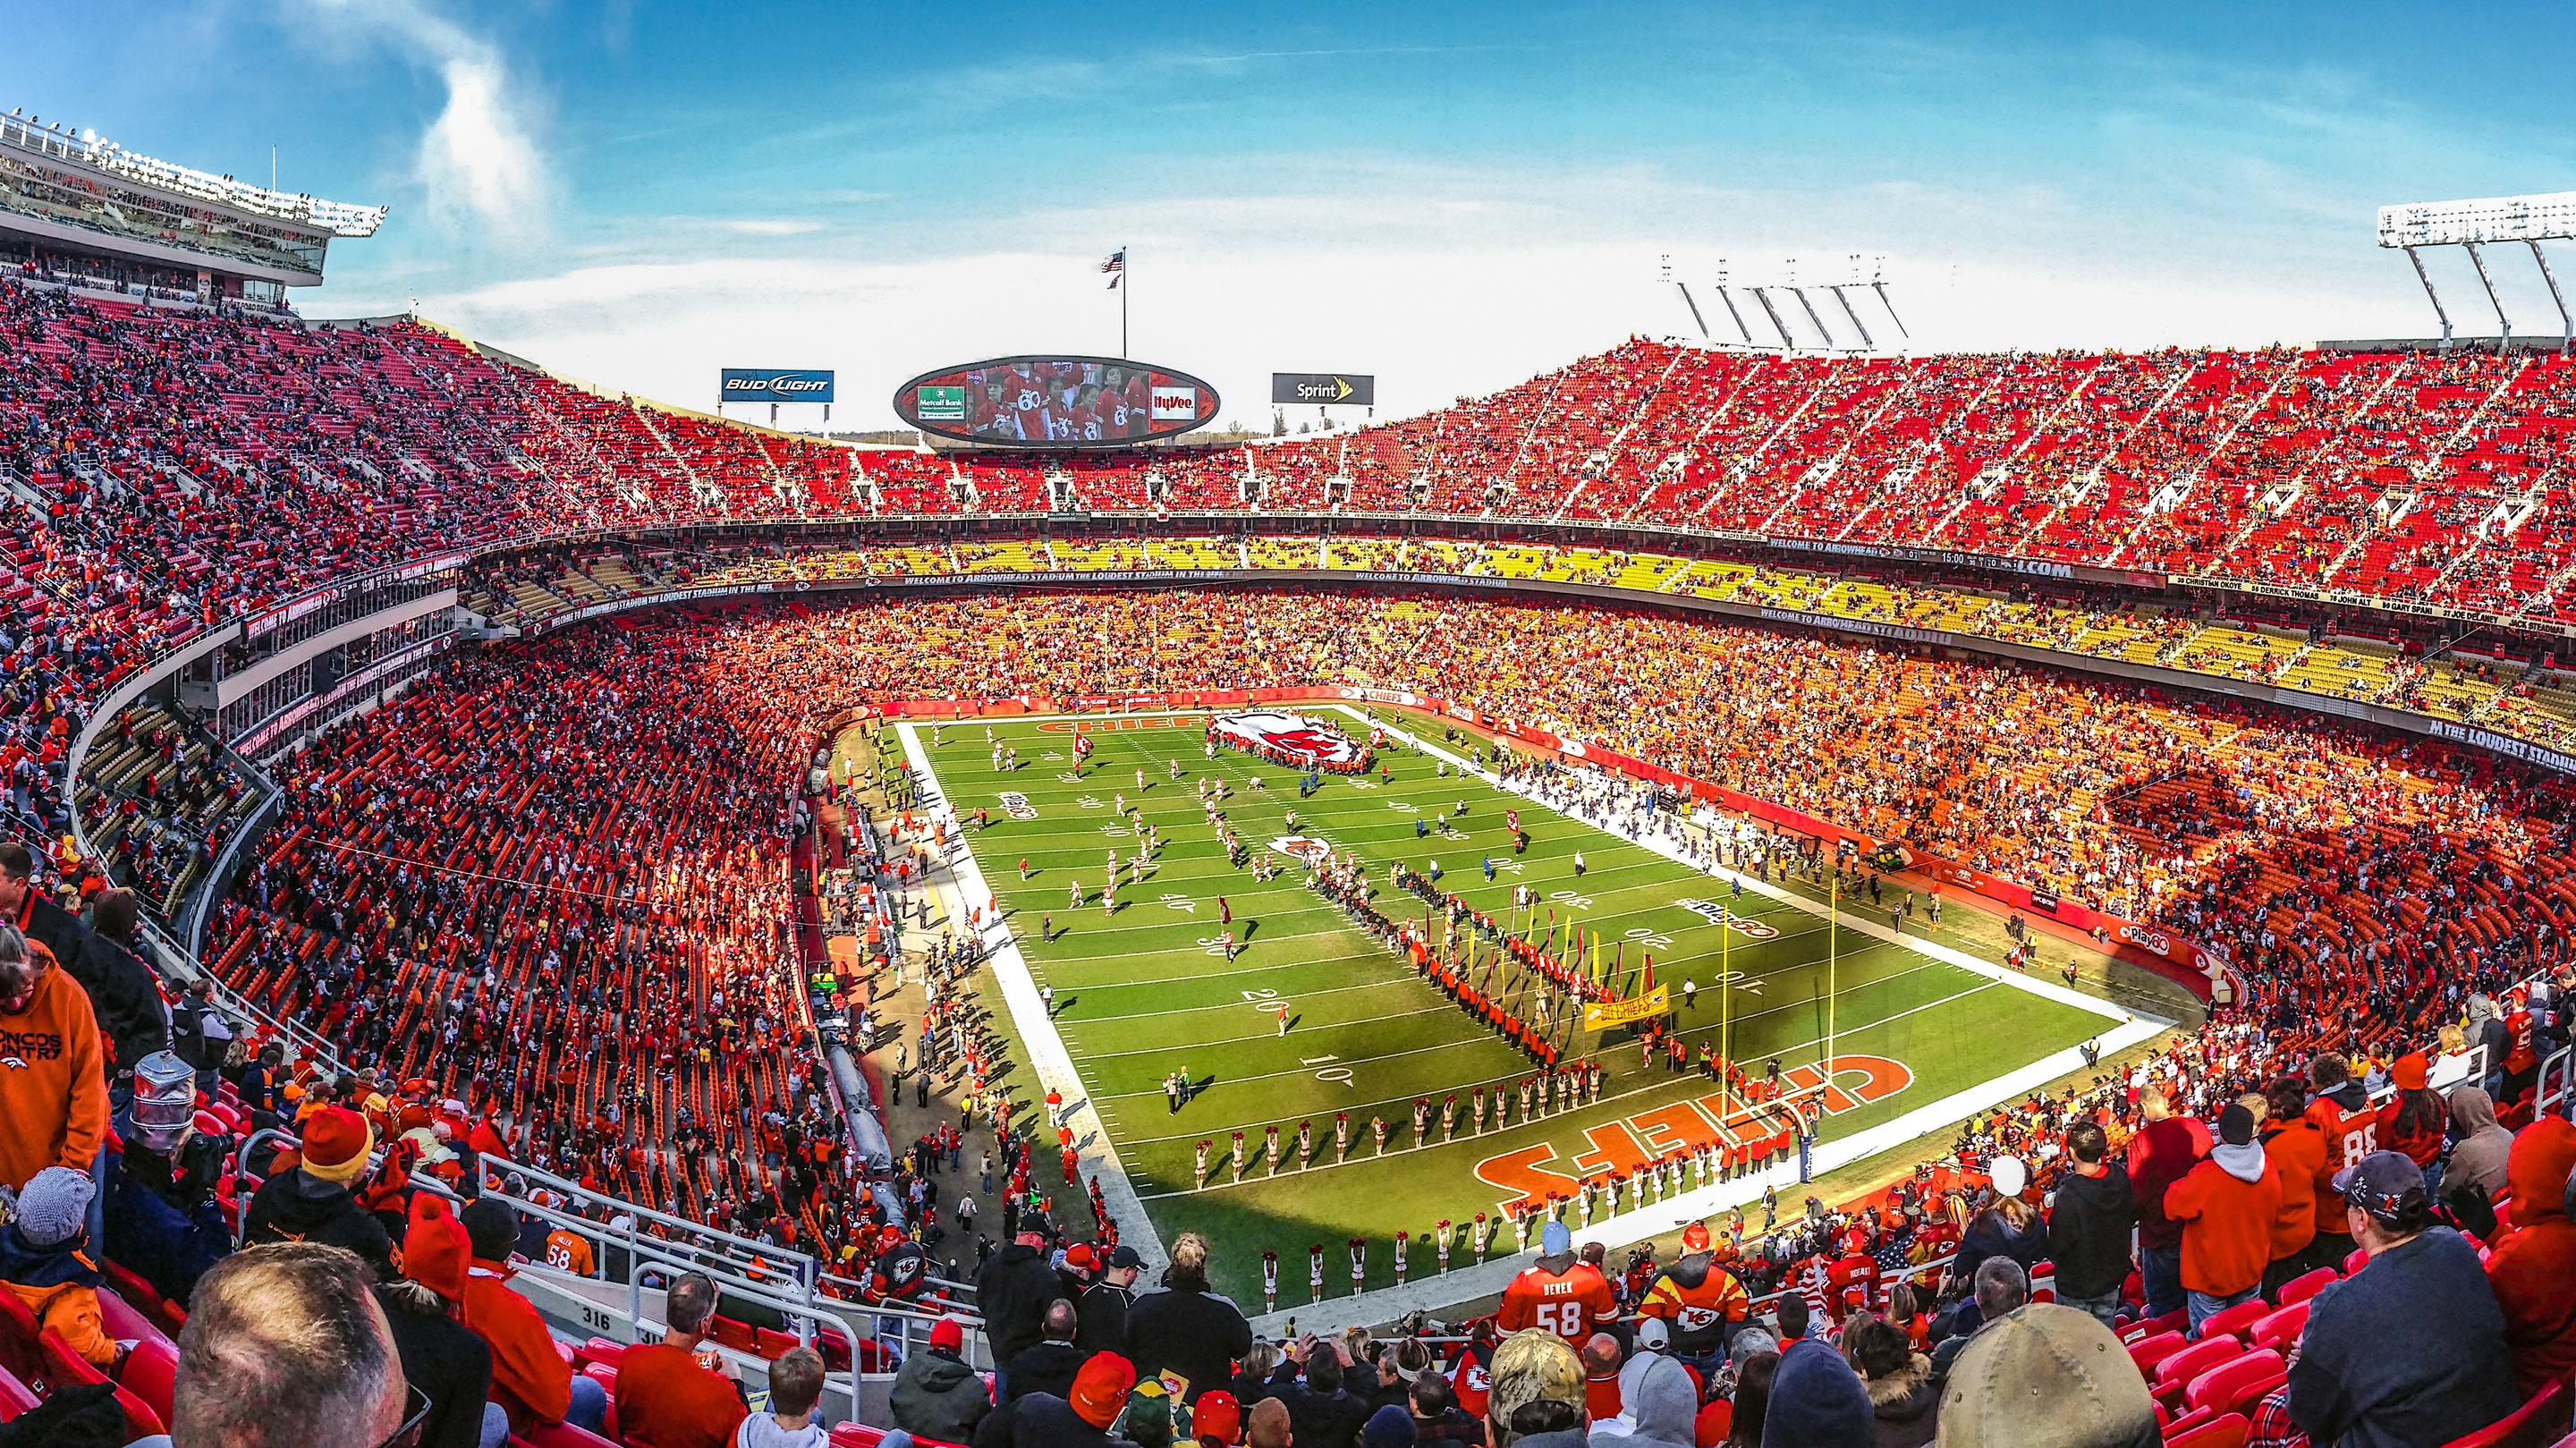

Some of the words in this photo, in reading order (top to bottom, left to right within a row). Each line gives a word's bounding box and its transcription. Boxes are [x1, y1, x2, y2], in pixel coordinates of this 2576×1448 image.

[724, 378, 768, 390] BUD
[776, 379, 827, 391] LIGHT
[1297, 383, 1336, 400] Sprint
[1018, 391, 1040, 411] 60
[1770, 538, 1809, 550] WELCOME
[1812, 542, 1824, 551] TO
[1942, 552, 1964, 564] 15:00
[401, 564, 424, 580] WELCOME
[425, 563, 434, 575] TO
[904, 576, 948, 585] WELCOME
[949, 575, 963, 583] TO
[965, 573, 1029, 583] ARROWHEAD
[1092, 572, 1134, 580] LOUDEST
[1189, 570, 1206, 578] THE
[1355, 572, 1398, 581] WELCOME
[1399, 572, 1410, 580] TO
[361, 578, 375, 592] 15:00
[2185, 578, 2219, 588] CHRISTIAN
[2220, 581, 2241, 589] OKOYE
[2260, 587, 2290, 596] DERRICK
[2291, 591, 2319, 599] THOMAS
[2338, 597, 2357, 605] JOHN
[2358, 598, 2371, 606] ALT
[552, 613, 574, 628] WELCOME
[574, 609, 581, 620] TO
[581, 601, 618, 618] ARROWHEAD
[618, 597, 648, 611] STADIUM
[648, 595, 659, 604] THE
[659, 589, 692, 602] LOUDEST
[728, 586, 738, 595] IN
[740, 585, 755, 594] THE
[2391, 603, 2410, 612] GARY
[1760, 608, 1800, 622] WELCOME
[1801, 614, 1812, 623] TO
[2452, 611, 2465, 619] JOE
[2466, 613, 2498, 624] DELANEY
[2509, 619, 2527, 629] JACK
[248, 612, 278, 639] WELCOME
[278, 610, 286, 624] TO
[1368, 690, 1402, 702] CHIEFS
[240, 732, 269, 755] WELCOME
[270, 723, 277, 737] TO
[357, 664, 381, 687] LOUDEST
[1037, 716, 1207, 733] CHIEF
[2445, 723, 2466, 740] THE
[2468, 728, 2529, 758] LOUDEST
[1159, 893, 1196, 910] 40
[1550, 890, 1593, 908] 30
[1624, 928, 1674, 947] 20
[1715, 971, 1767, 992] 10
[1241, 988, 1290, 1012] 20
[1299, 1054, 1353, 1081] 10
[557, 1235, 572, 1247] MILLER
[547, 1243, 571, 1270] 58
[1544, 1282, 1572, 1296] DEREK
[583, 1308, 610, 1331] 316
[1537, 1301, 1581, 1336] 58
